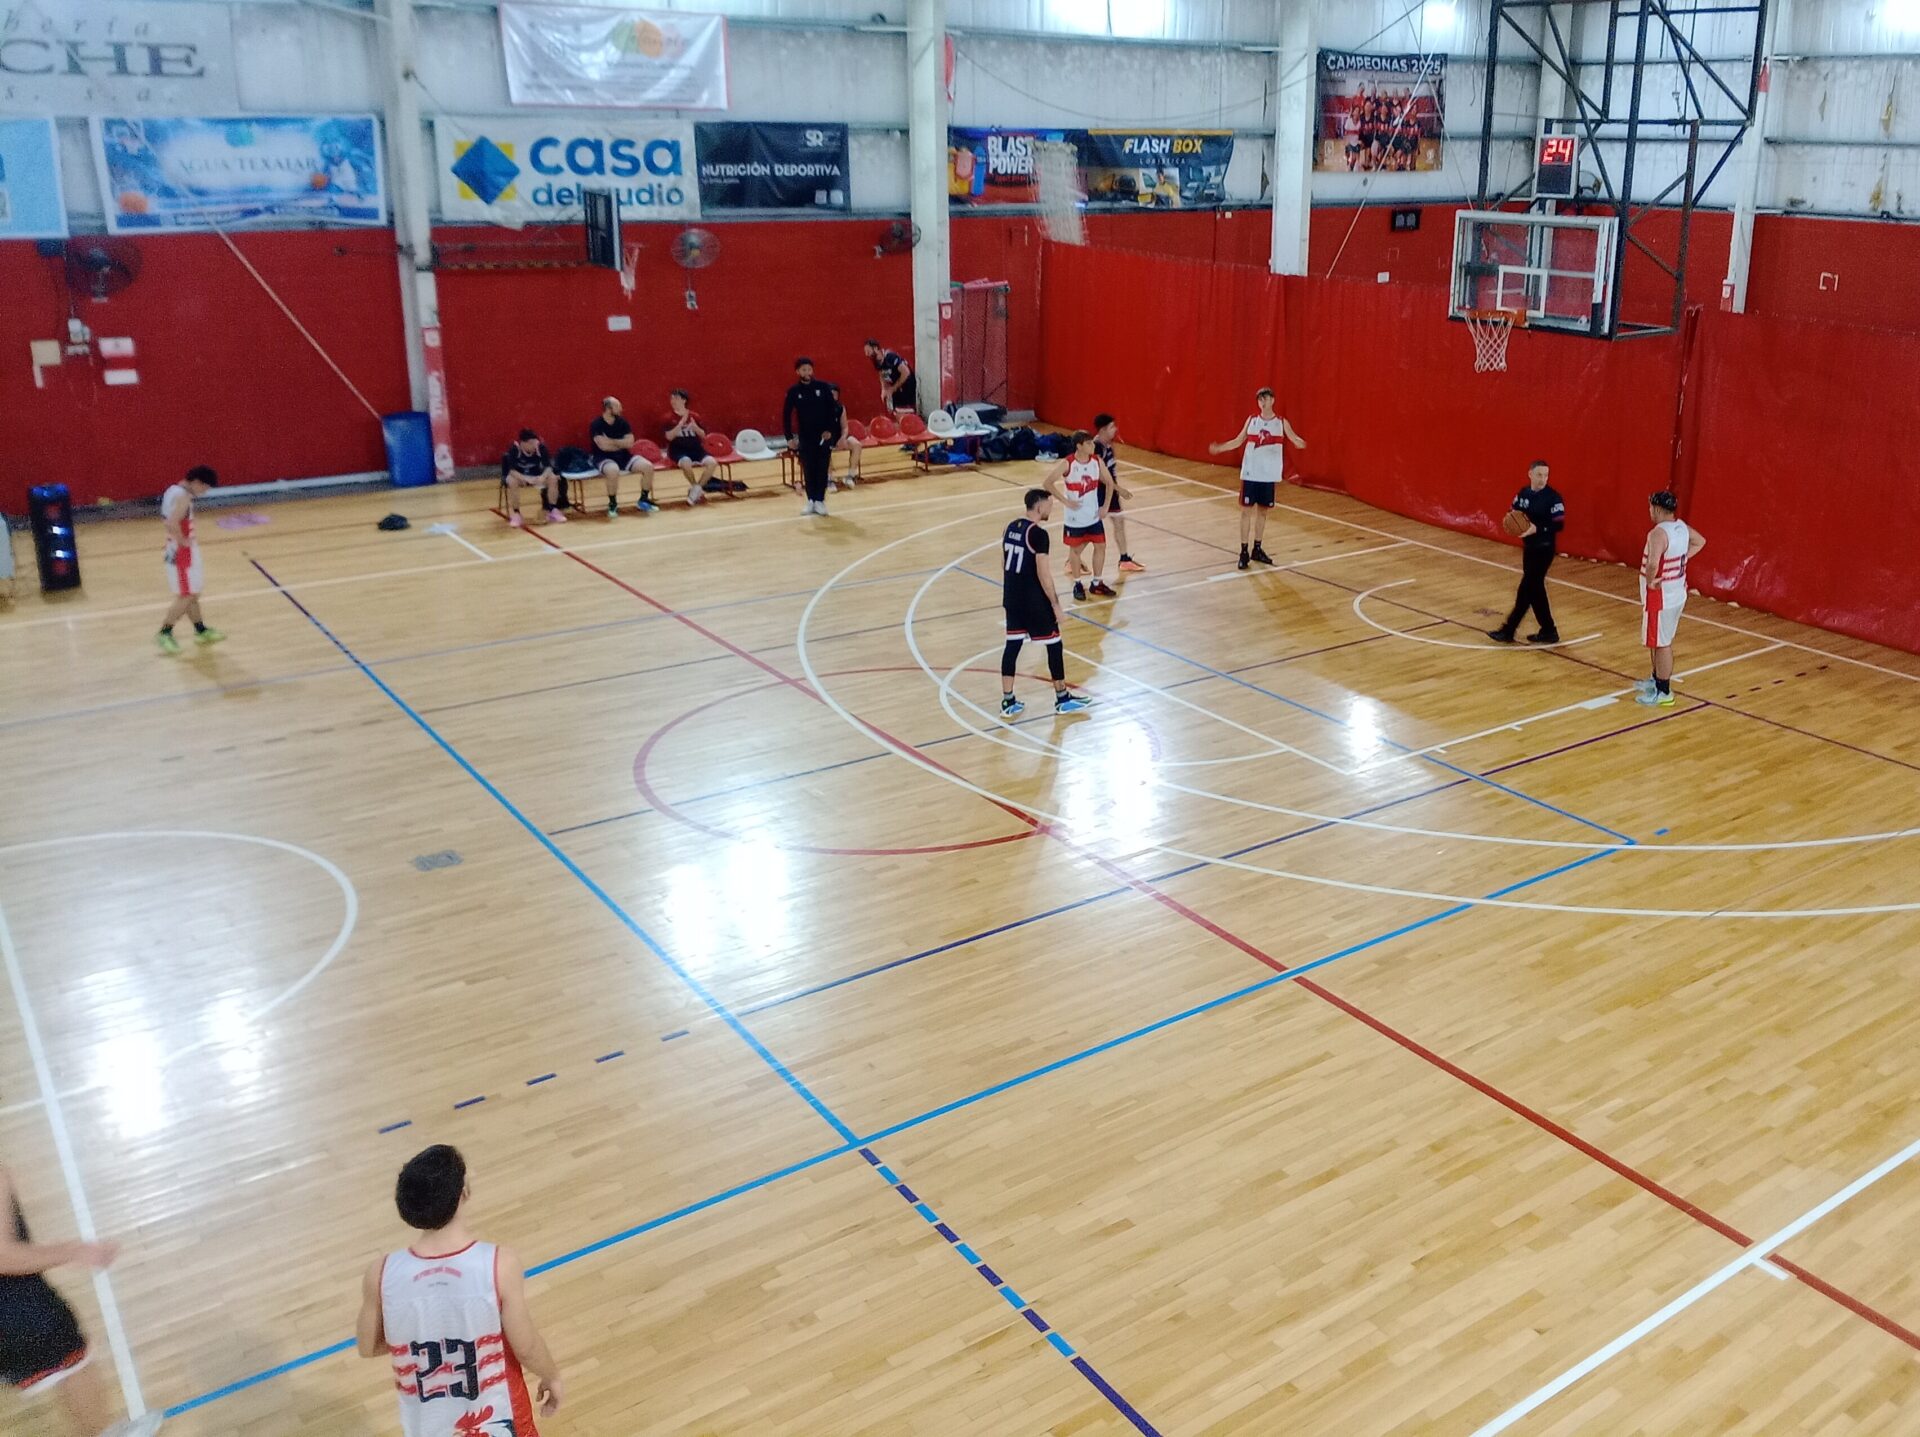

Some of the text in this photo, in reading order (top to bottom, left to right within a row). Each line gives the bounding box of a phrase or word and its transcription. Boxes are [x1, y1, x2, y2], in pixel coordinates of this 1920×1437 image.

[1326, 53, 1441, 75] CAMPEONAS 2025
[529, 136, 683, 177] casa
[987, 135, 1034, 157] BLAST
[1122, 138, 1203, 154] FLASH BOX
[1542, 139, 1572, 164] 24
[701, 161, 841, 177] NUTRICIÓN DEPORTIVA
[989, 156, 1034, 175] POWER
[1004, 542, 1025, 574] 77
[410, 1338, 480, 1403] 23
